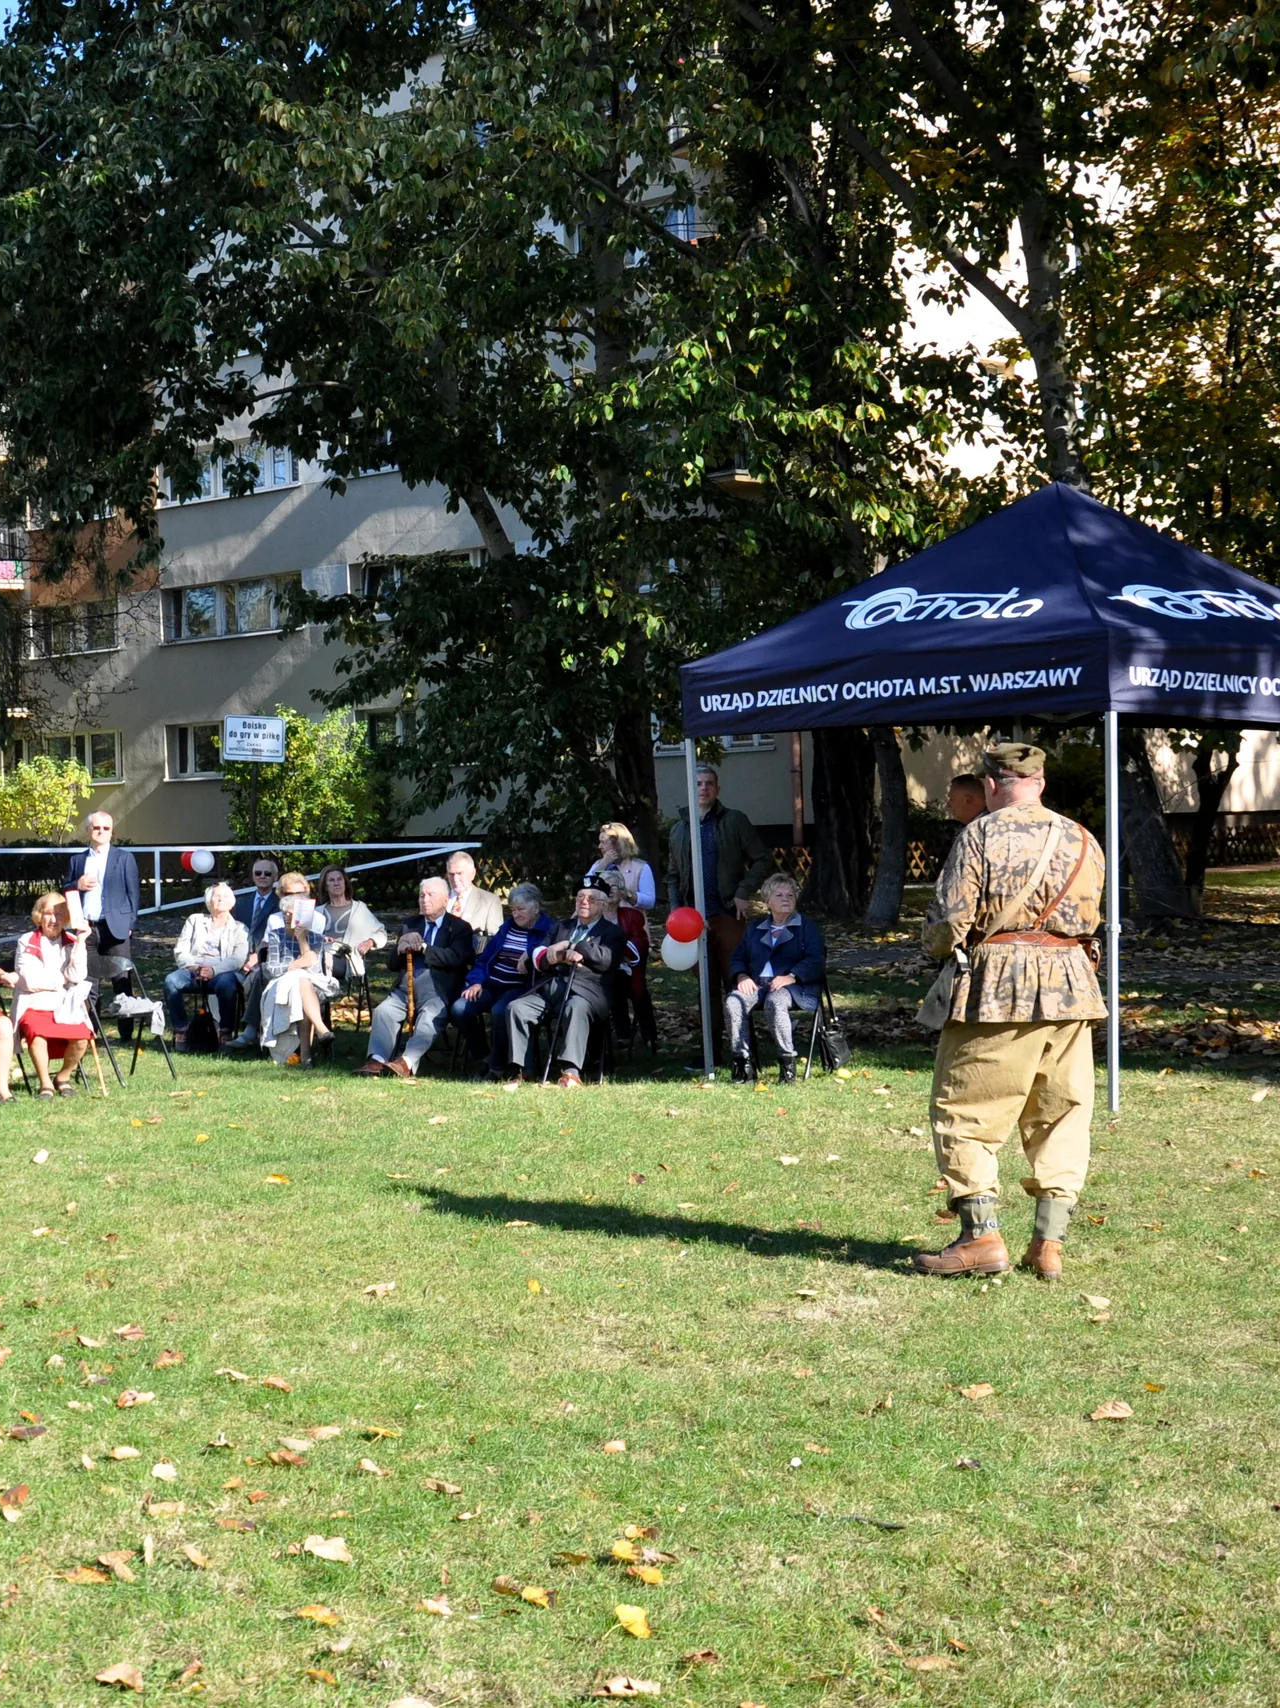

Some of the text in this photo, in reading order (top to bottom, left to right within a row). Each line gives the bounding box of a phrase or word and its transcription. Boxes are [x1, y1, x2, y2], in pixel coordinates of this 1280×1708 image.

[700, 666, 1082, 712] URZĄD DZIELNICY OCHOTA M.ST. WARSZAWY
[1129, 665, 1181, 691] URZĄD
[1183, 670, 1258, 694] DZIELNICY
[228, 730, 238, 738] do
[240, 731, 251, 740] gry
[242, 721, 267, 730] Boisko
